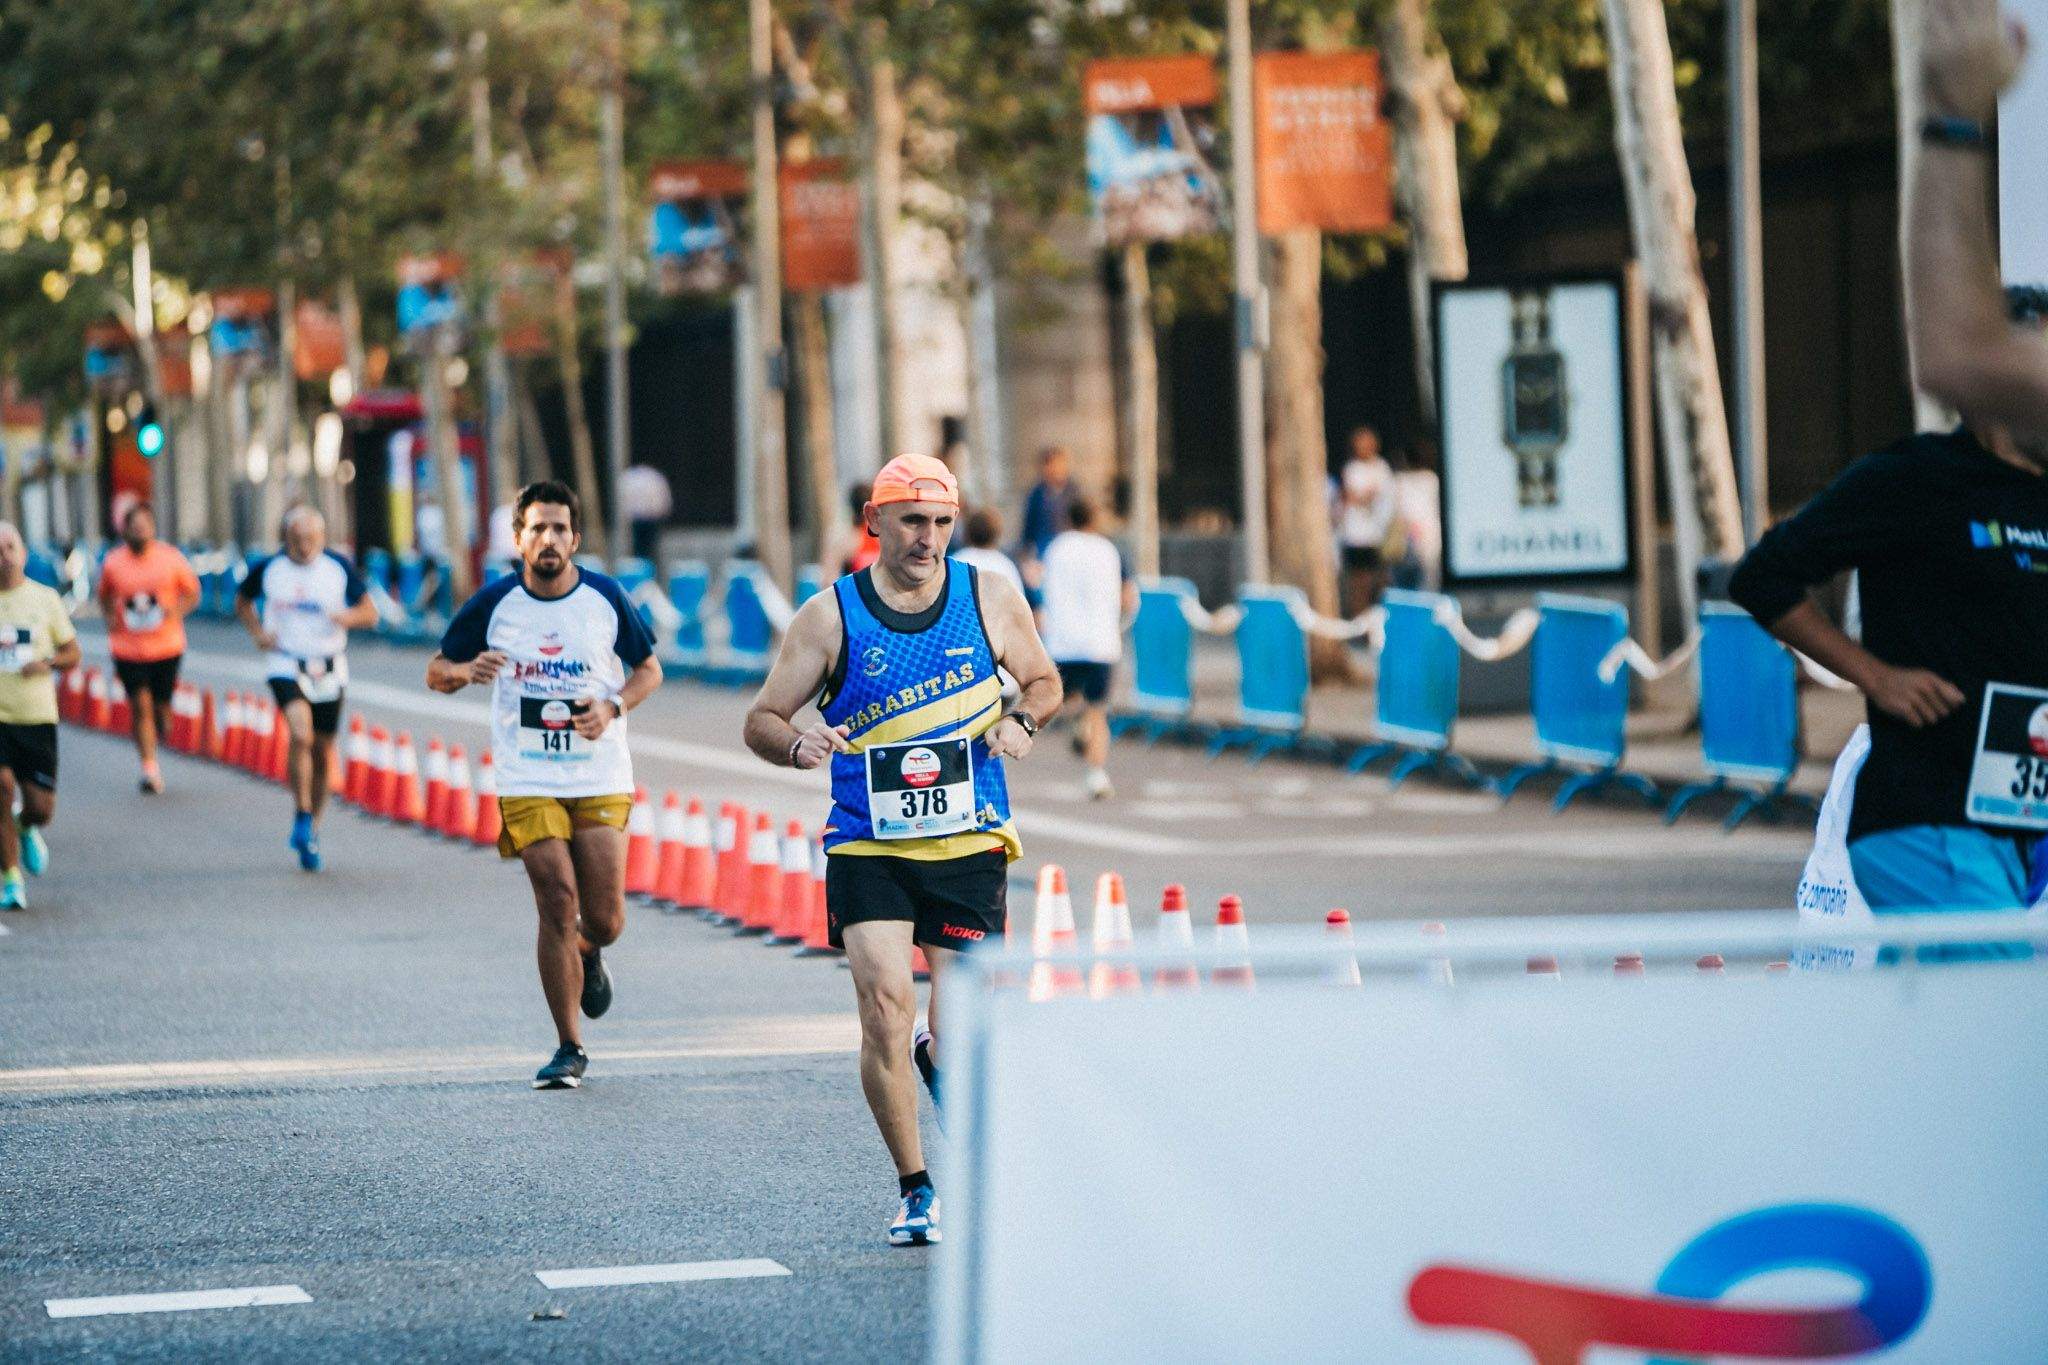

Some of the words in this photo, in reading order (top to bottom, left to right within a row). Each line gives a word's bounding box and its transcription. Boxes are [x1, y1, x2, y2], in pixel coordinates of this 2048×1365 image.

[1475, 529, 1604, 553] CHANEL
[2005, 524, 2048, 550] MetL
[843, 662, 976, 733] GARABITAS
[542, 731, 570, 752] 141
[900, 788, 948, 819] 378
[941, 922, 986, 941] HOKO
